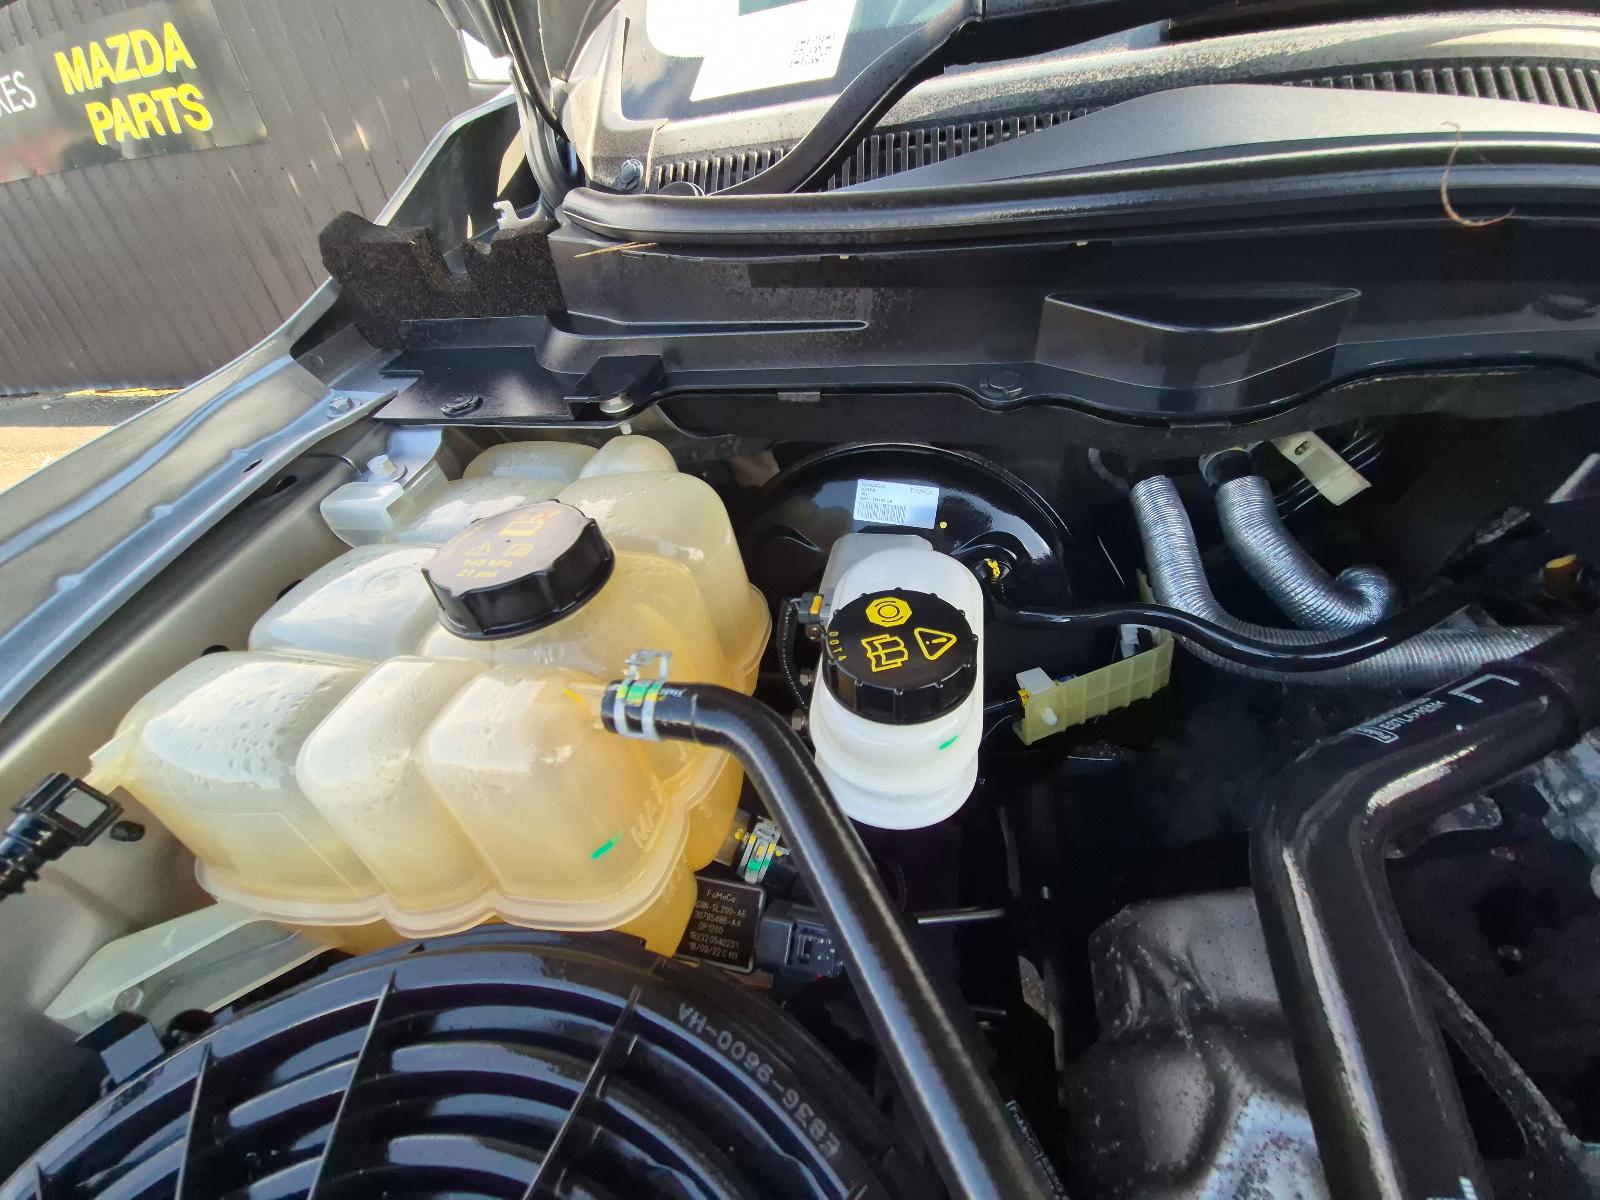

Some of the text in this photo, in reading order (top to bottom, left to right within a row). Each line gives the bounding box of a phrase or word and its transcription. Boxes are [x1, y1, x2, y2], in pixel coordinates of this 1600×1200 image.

[54, 22, 197, 96] MAZDA
[85, 83, 214, 146] PARTS
[706, 889, 737, 903] FoMoCo
